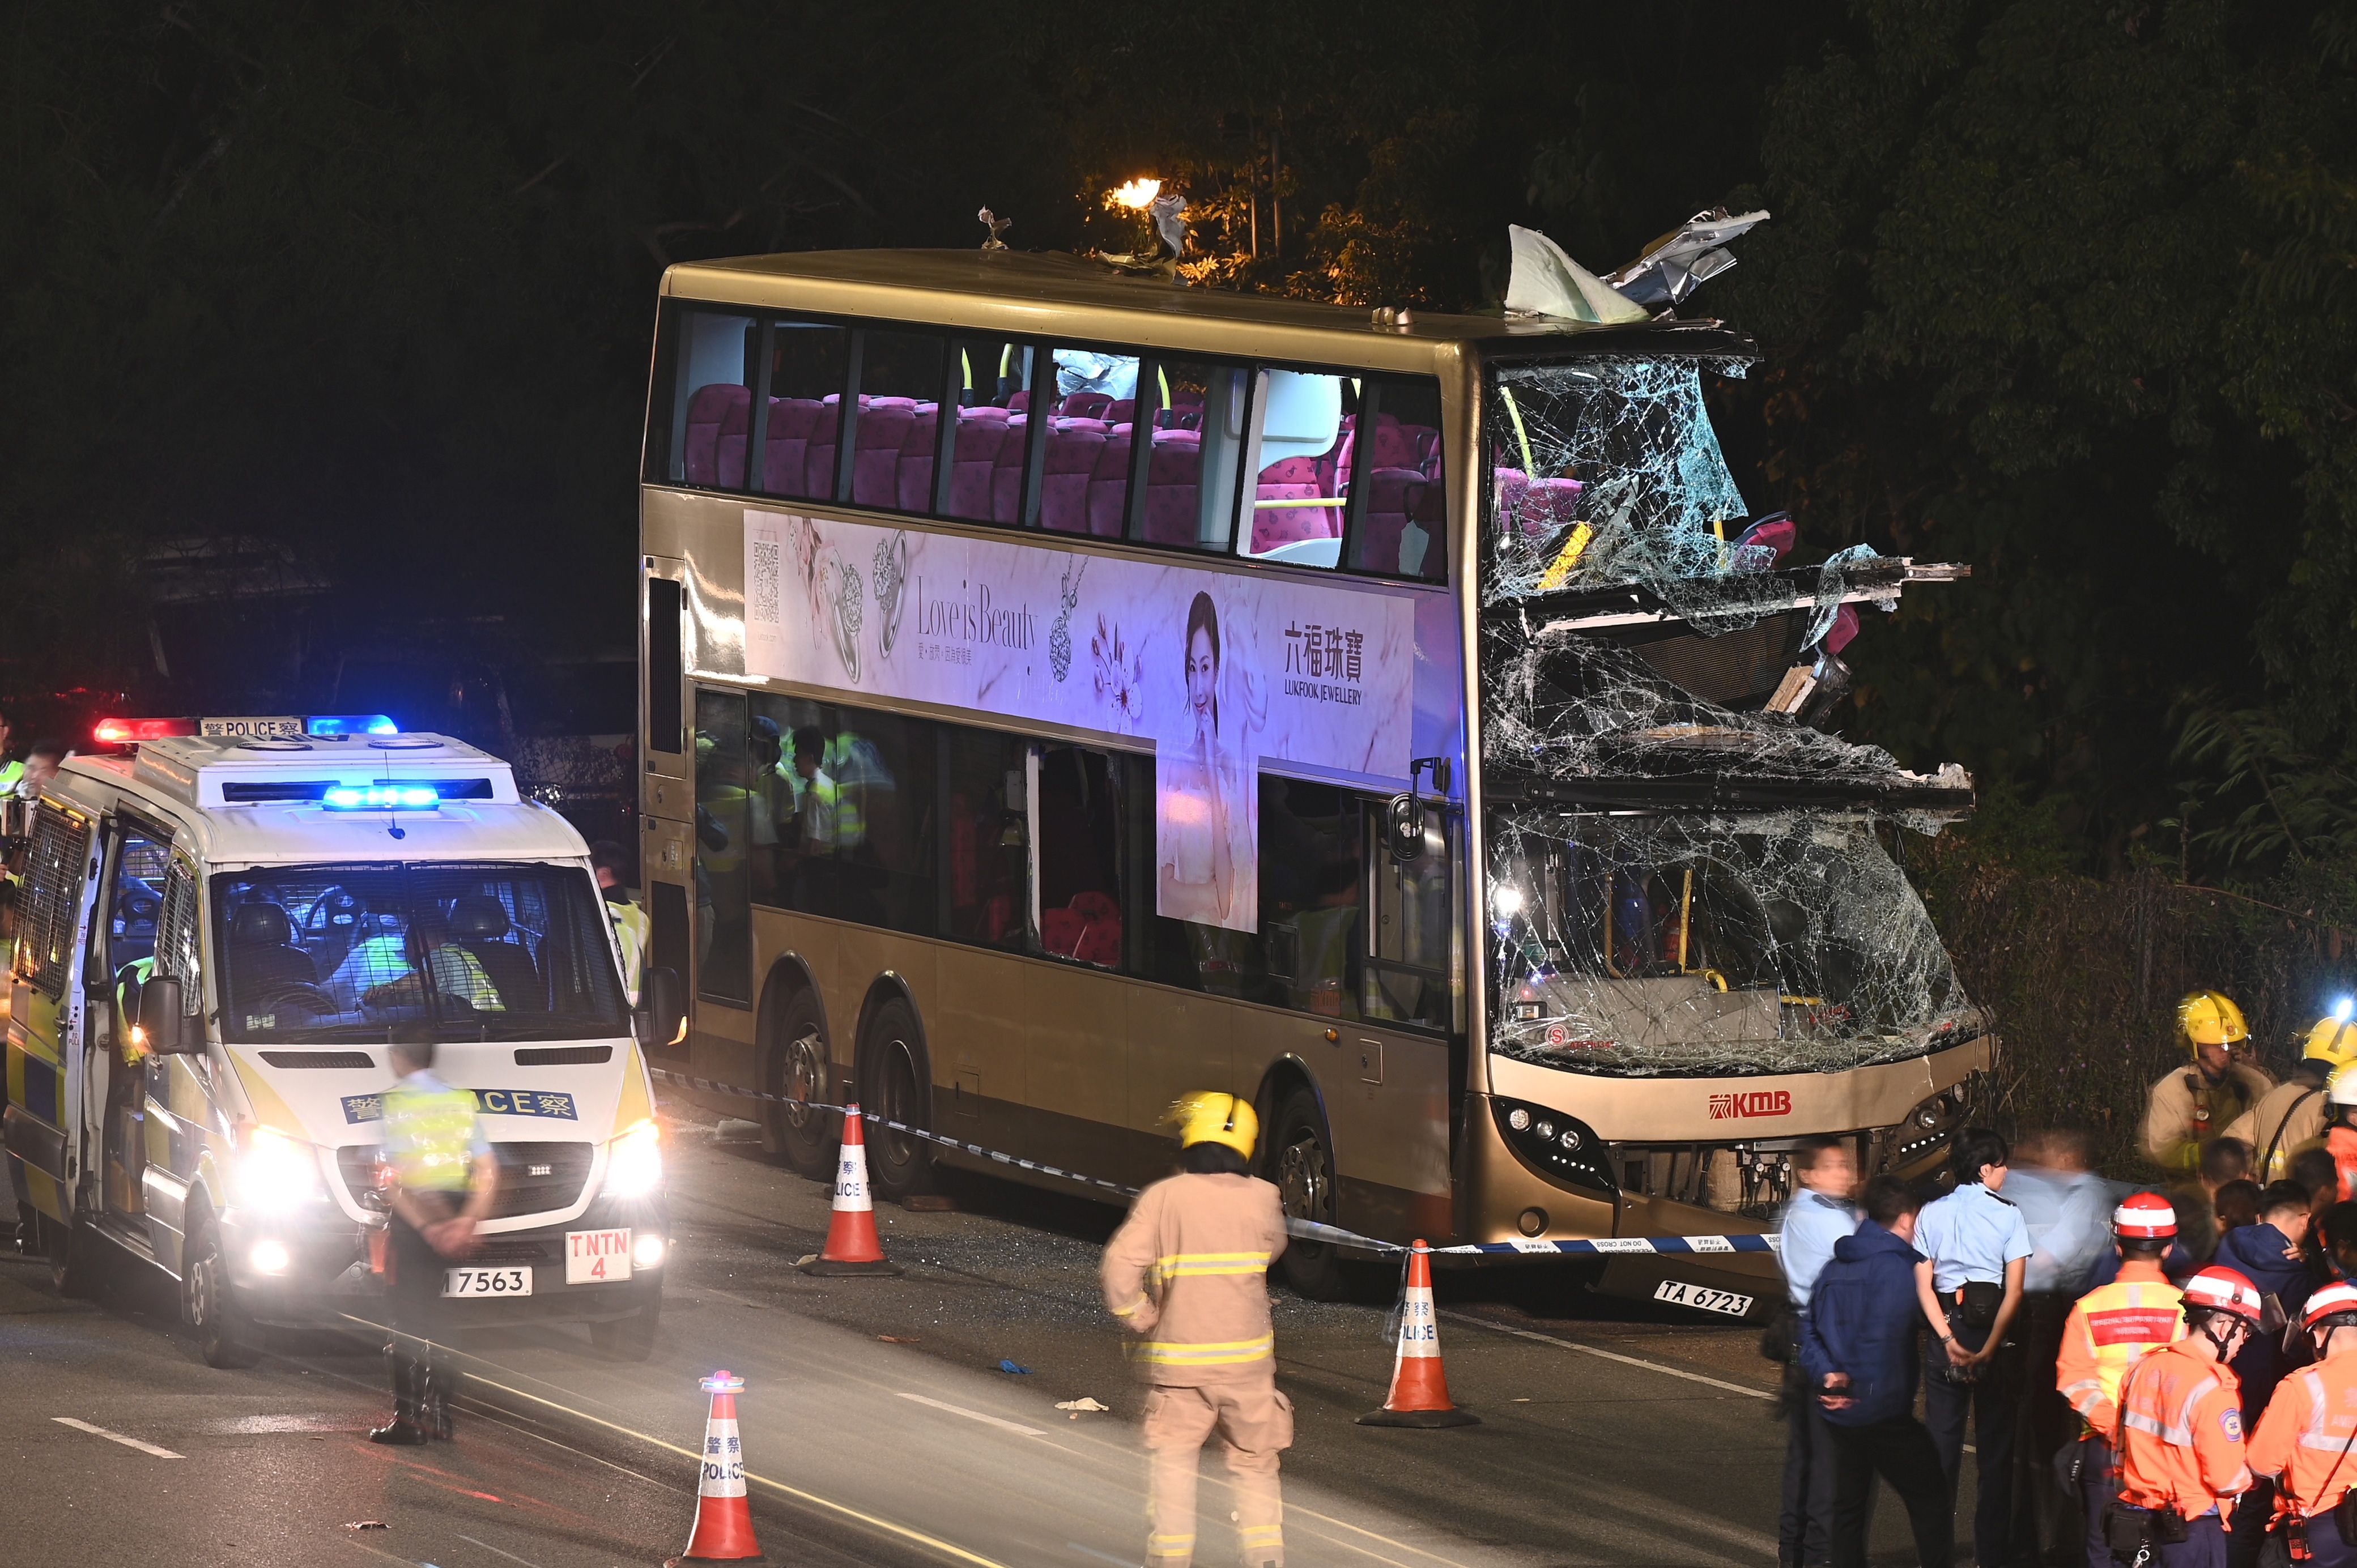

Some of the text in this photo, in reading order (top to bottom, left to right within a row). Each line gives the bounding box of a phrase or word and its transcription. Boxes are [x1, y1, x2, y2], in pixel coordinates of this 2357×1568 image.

[917, 576, 1039, 675] Love is Beauty
[1285, 620, 1363, 683] 六福珠寶
[1284, 679, 1362, 706] LUKFOOK JEWELLERY
[226, 722, 277, 736] POLICE
[539, 1094, 571, 1117] 察
[836, 1182, 860, 1196] LICE
[570, 1232, 627, 1257] TNTN
[591, 1257, 606, 1279] 4
[458, 1271, 523, 1293] 7563
[1662, 1281, 1748, 1313] TA 6723
[1403, 1324, 1434, 1340] LICE
[707, 1436, 739, 1454] 警察
[703, 1462, 744, 1480] POLICE
